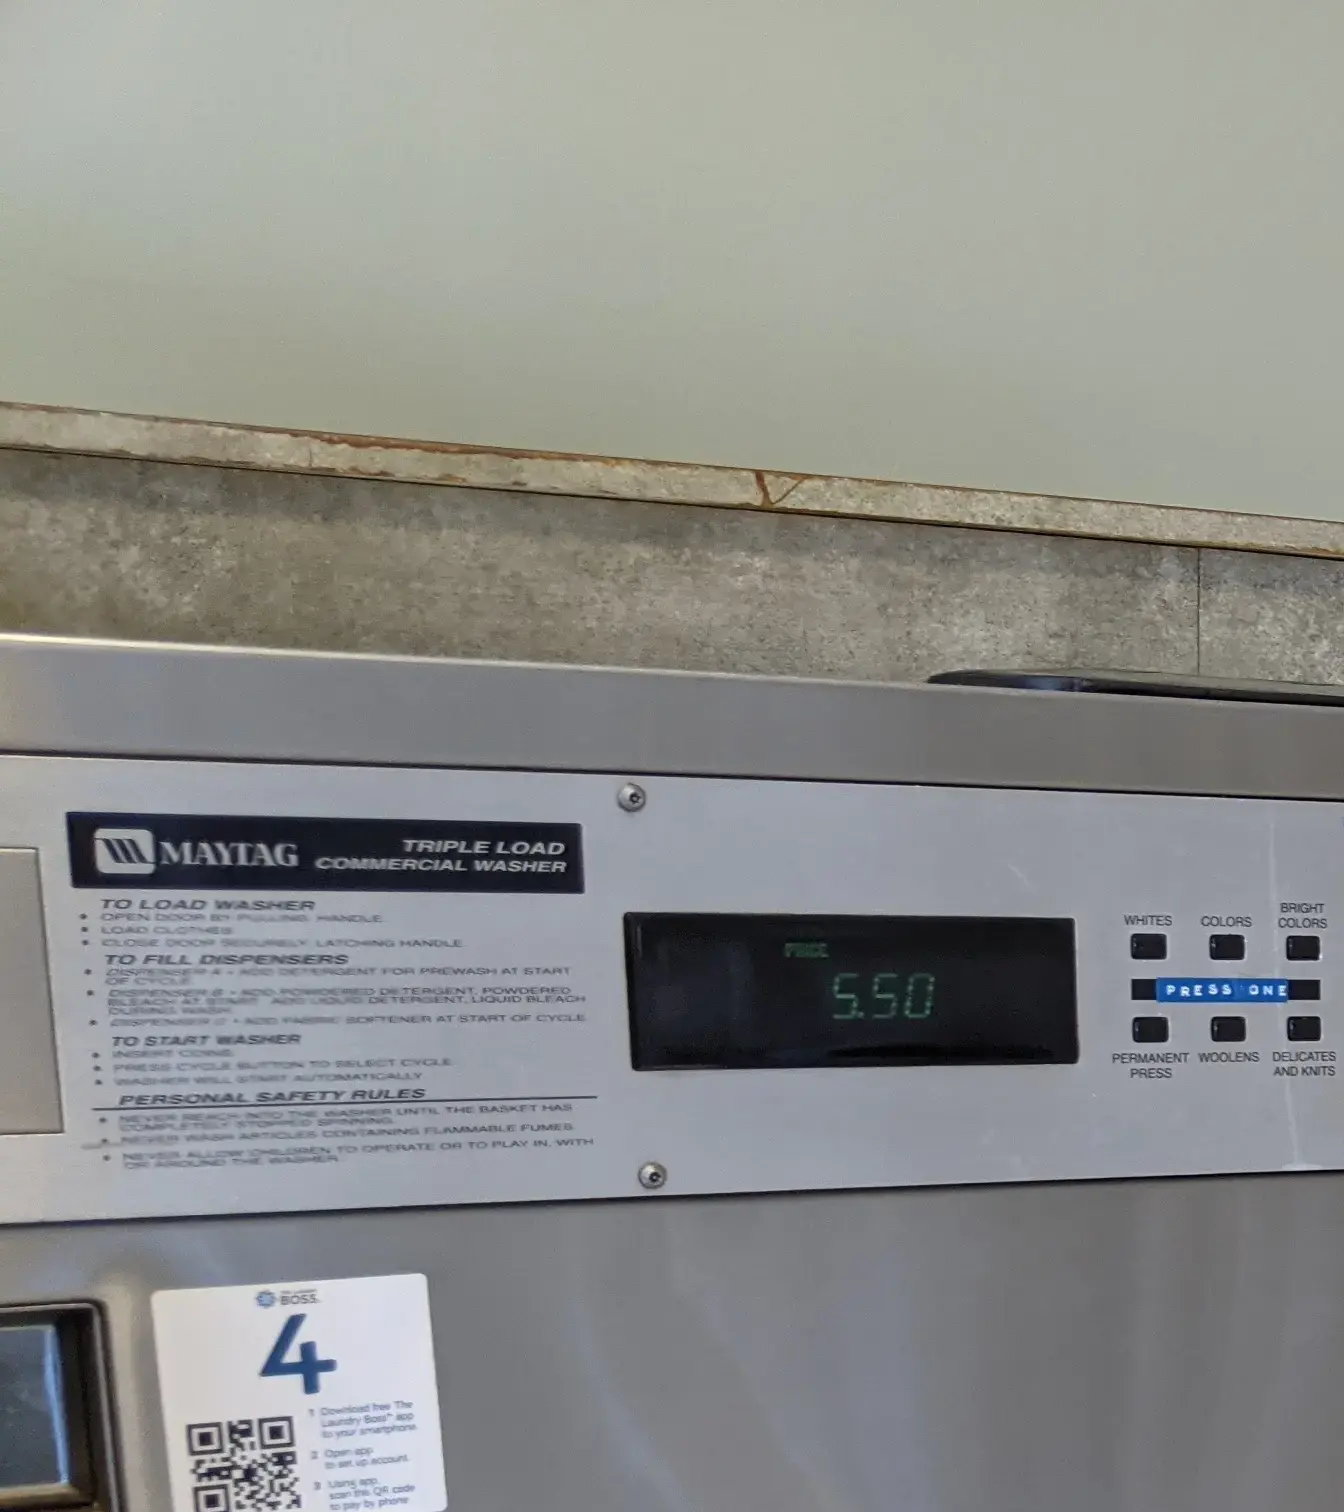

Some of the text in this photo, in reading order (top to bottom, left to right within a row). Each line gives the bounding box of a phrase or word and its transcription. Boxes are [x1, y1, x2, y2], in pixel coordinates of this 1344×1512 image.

[403, 839, 566, 855] TRIPLE LOAD
[160, 842, 298, 867] MAYTAG
[316, 857, 567, 873] COMMERCIAL WASHER
[102, 900, 316, 911] TO LOAD WASHER
[1280, 903, 1325, 914] BRIGHT
[1124, 915, 1173, 927] WHITES
[1201, 916, 1252, 928] COLORS
[1278, 917, 1328, 929] COLORS
[104, 954, 348, 965] TO FILL DISPENSERS
[419, 967, 498, 976] PREWASH
[501, 967, 518, 975] AT
[523, 967, 571, 975] START
[831, 972, 936, 1020] 5.50
[1166, 983, 1287, 997] PRESS ONE
[436, 1015, 453, 1023] AT
[458, 1014, 507, 1023] START
[510, 1014, 531, 1023] OF
[112, 1034, 302, 1047] TO START WASHER
[1112, 1052, 1190, 1064] PERMANENT
[1197, 1051, 1260, 1063] WOOLENS
[1272, 1051, 1337, 1063] DELICATES
[1130, 1068, 1173, 1079] PRESS
[1273, 1066, 1336, 1077] AND KNITS
[118, 1088, 426, 1105] PERSONAL SAFETY RULES
[446, 1106, 476, 1114] THE
[468, 1141, 488, 1149] TO
[555, 1138, 594, 1147] WITH
[259, 1313, 337, 1395] 4
